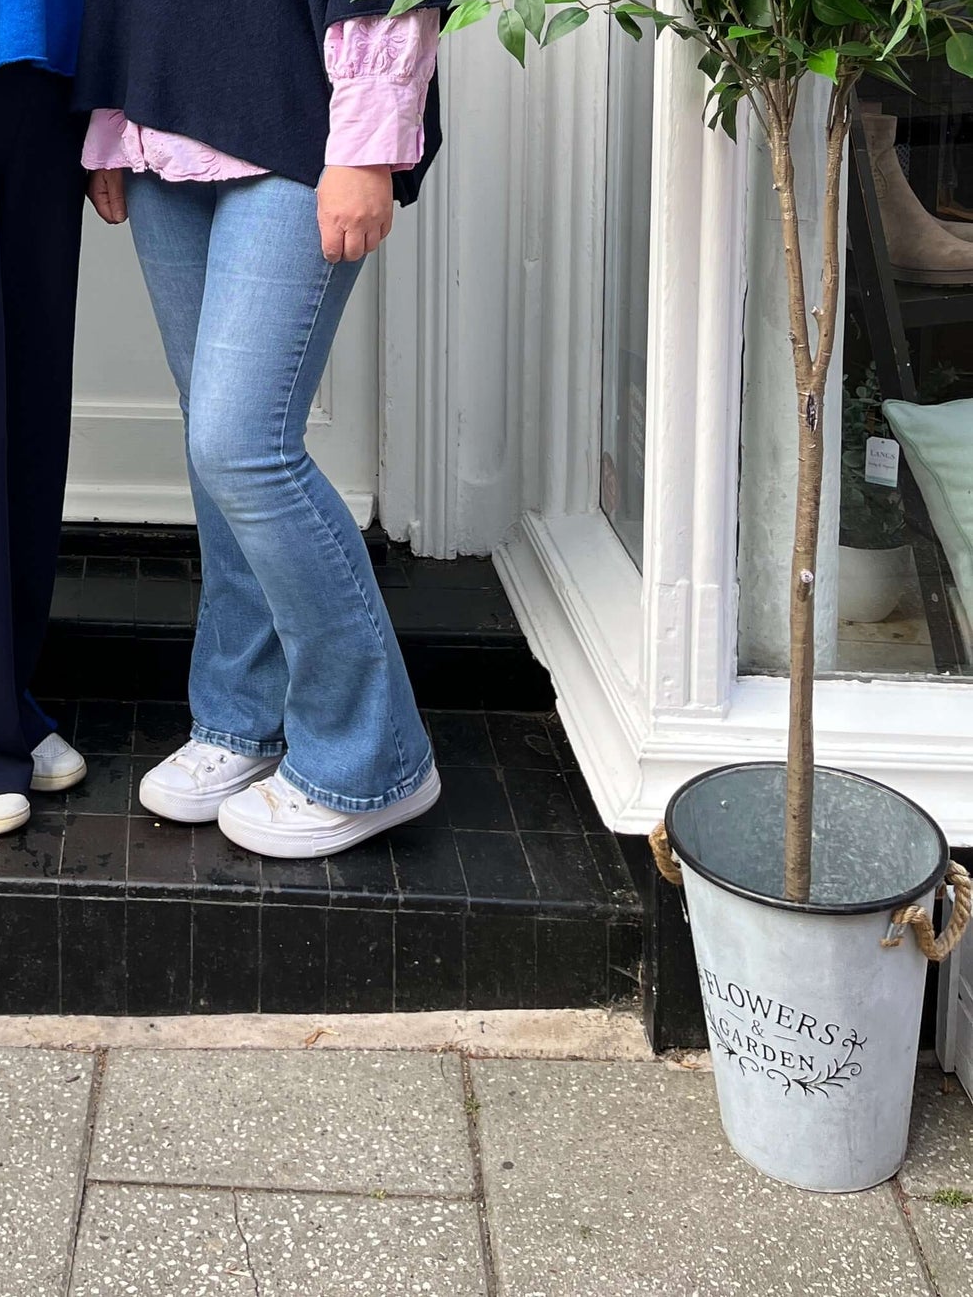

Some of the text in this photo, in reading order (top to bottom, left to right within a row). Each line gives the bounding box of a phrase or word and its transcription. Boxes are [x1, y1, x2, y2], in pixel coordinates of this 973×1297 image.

[704, 968, 840, 1045] FLOWERS
[751, 1019, 765, 1039] &
[719, 1018, 814, 1072] GARDEN
